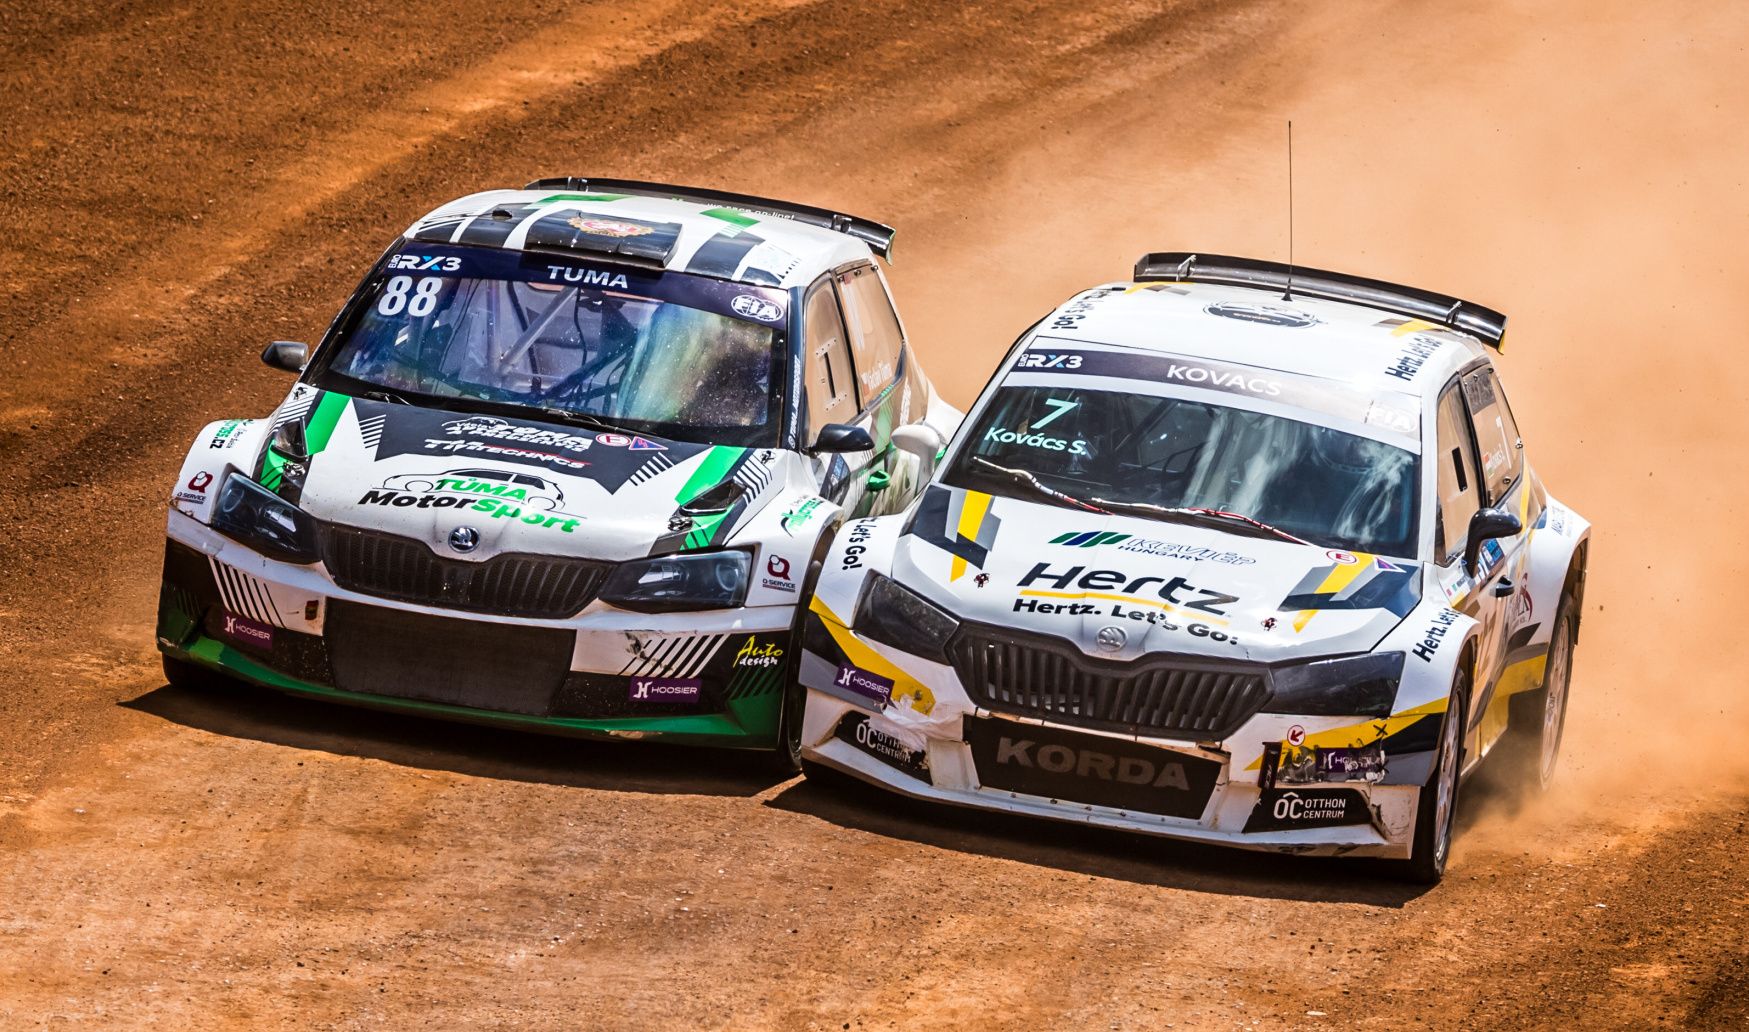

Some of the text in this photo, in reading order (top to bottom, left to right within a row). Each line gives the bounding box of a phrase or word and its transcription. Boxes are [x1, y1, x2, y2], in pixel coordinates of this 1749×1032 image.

[397, 254, 462, 271] RX3
[547, 265, 628, 289] TUMA
[378, 275, 443, 317] 88
[734, 296, 777, 319] FIA
[1026, 354, 1083, 369] RX3
[1167, 364, 1282, 396] KOVACS
[1030, 398, 1079, 430] 7
[984, 427, 1087, 455] Kovács S.
[435, 477, 528, 500] TŮMA
[358, 490, 582, 533] MotorSport
[842, 545, 867, 570] Go!
[1118, 545, 1204, 561] HUNGARY
[1016, 562, 1240, 615] Hertz
[1013, 598, 1102, 615] Hertz.
[235, 624, 271, 640] HOOSIER
[732, 635, 783, 668] Auto
[739, 655, 778, 668] design
[651, 686, 698, 695] HOOSIER
[853, 676, 890, 695] HOOSIER
[996, 736, 1190, 791] KORDA
[1303, 810, 1345, 819] CENTRUM
[1304, 798, 1346, 809] OTTHON
